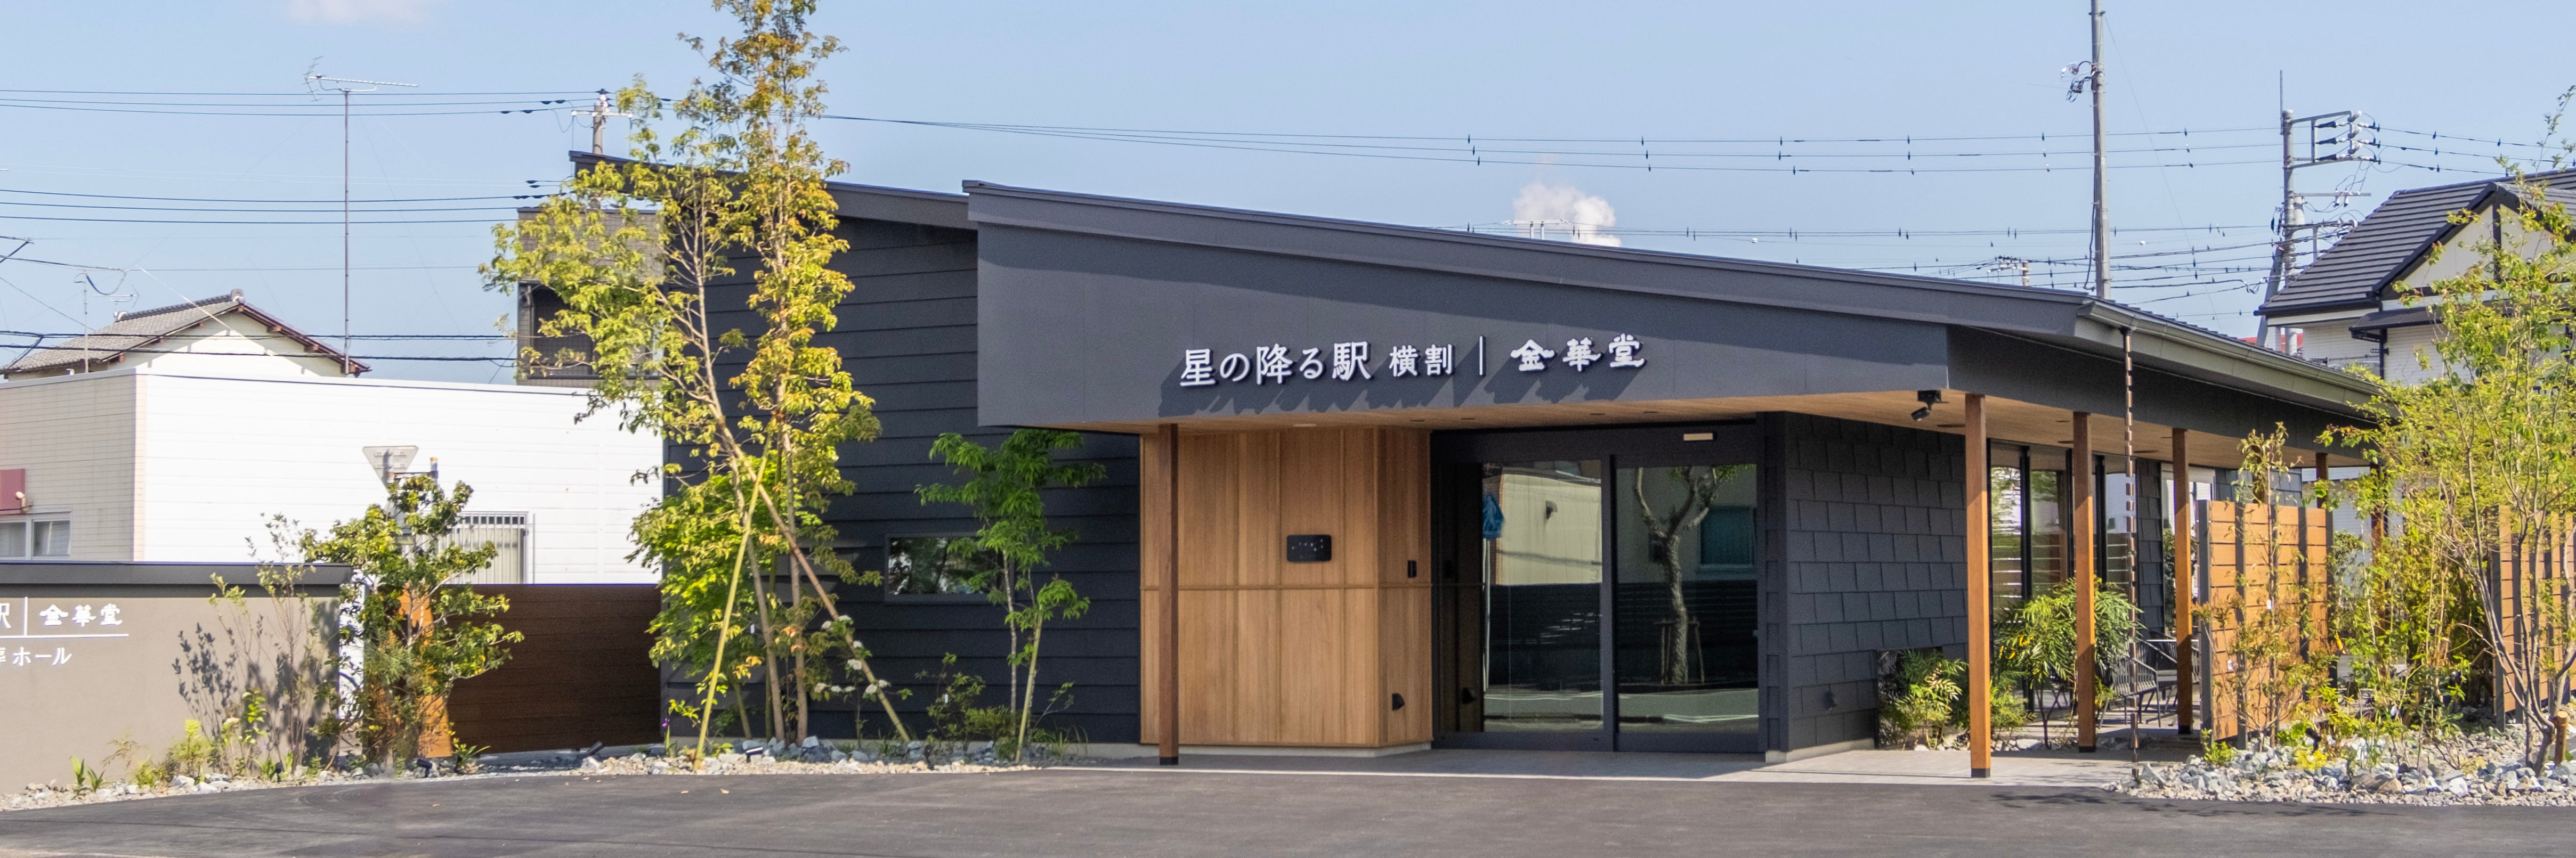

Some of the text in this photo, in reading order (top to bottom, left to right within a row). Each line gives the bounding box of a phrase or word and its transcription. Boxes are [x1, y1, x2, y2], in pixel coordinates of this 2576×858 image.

[1180, 333, 1645, 387] 星の降る駅 横割 金華堂
[39, 603, 123, 627] 金華堂
